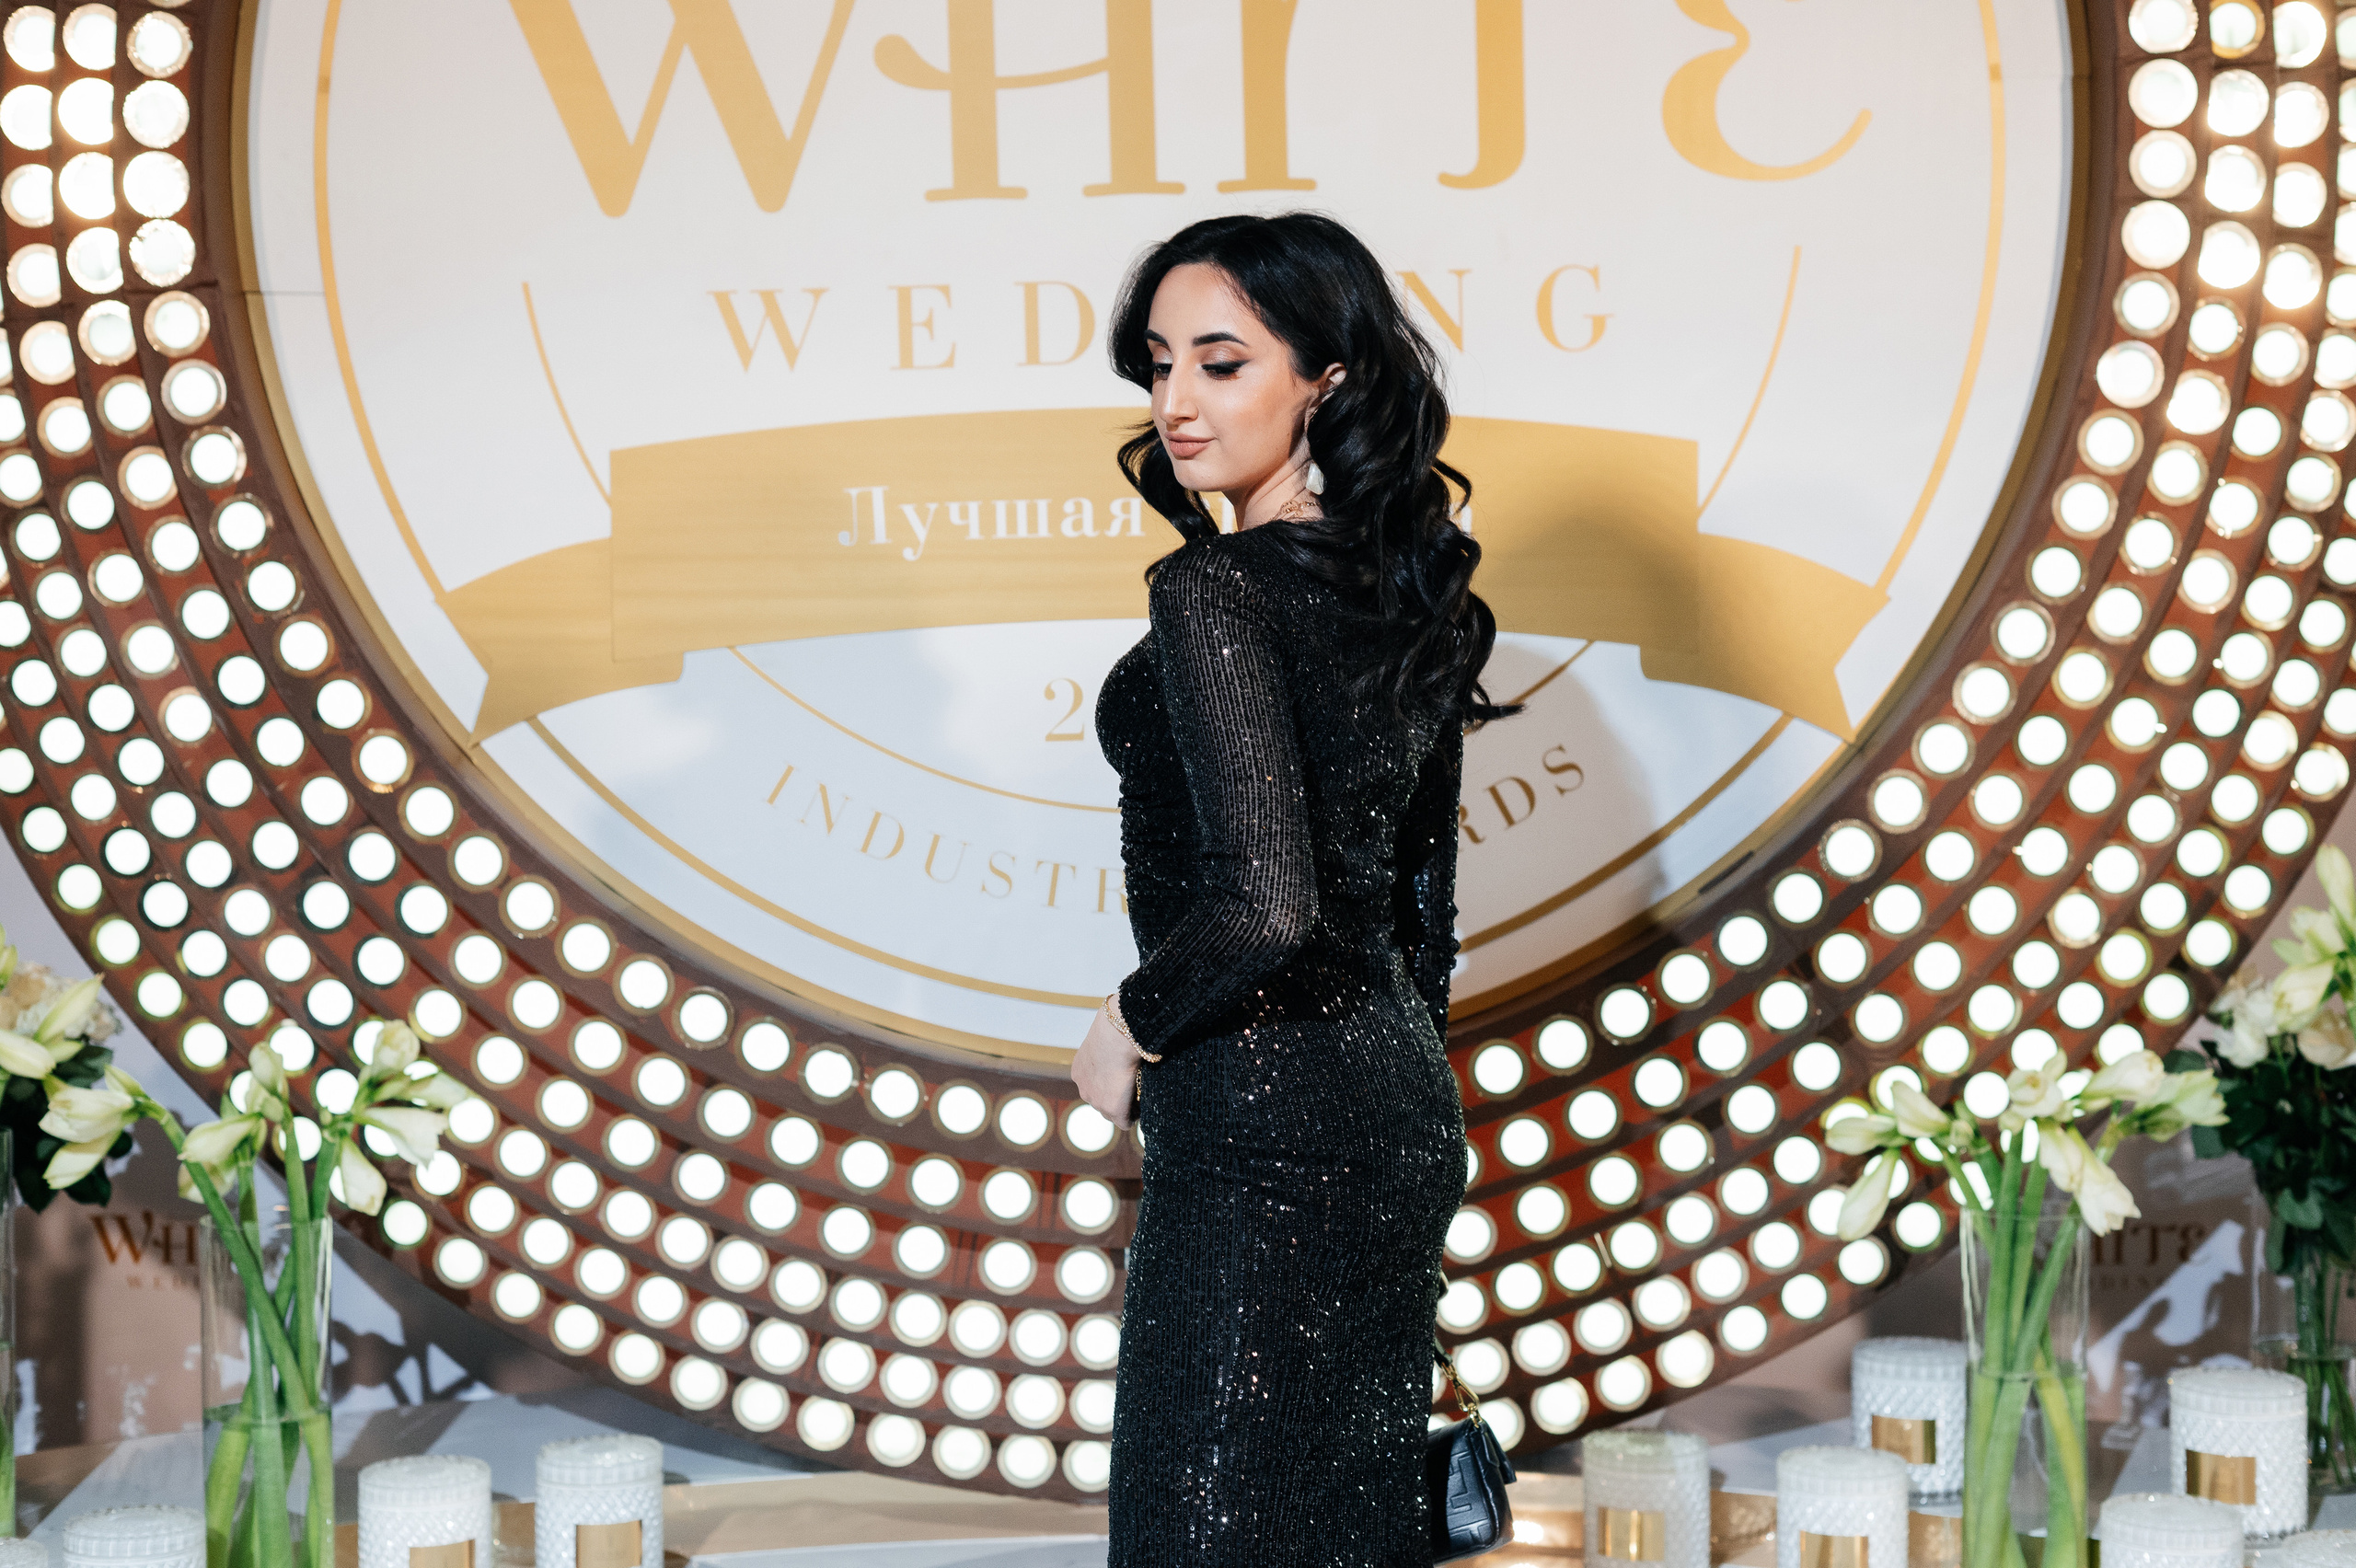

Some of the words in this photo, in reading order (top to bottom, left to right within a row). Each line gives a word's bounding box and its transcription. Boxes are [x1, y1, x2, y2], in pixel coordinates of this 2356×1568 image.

[706, 263, 1615, 373] WEDNG
[837, 485, 1145, 561] Лучшая
[761, 764, 1129, 916] INDUSTR
